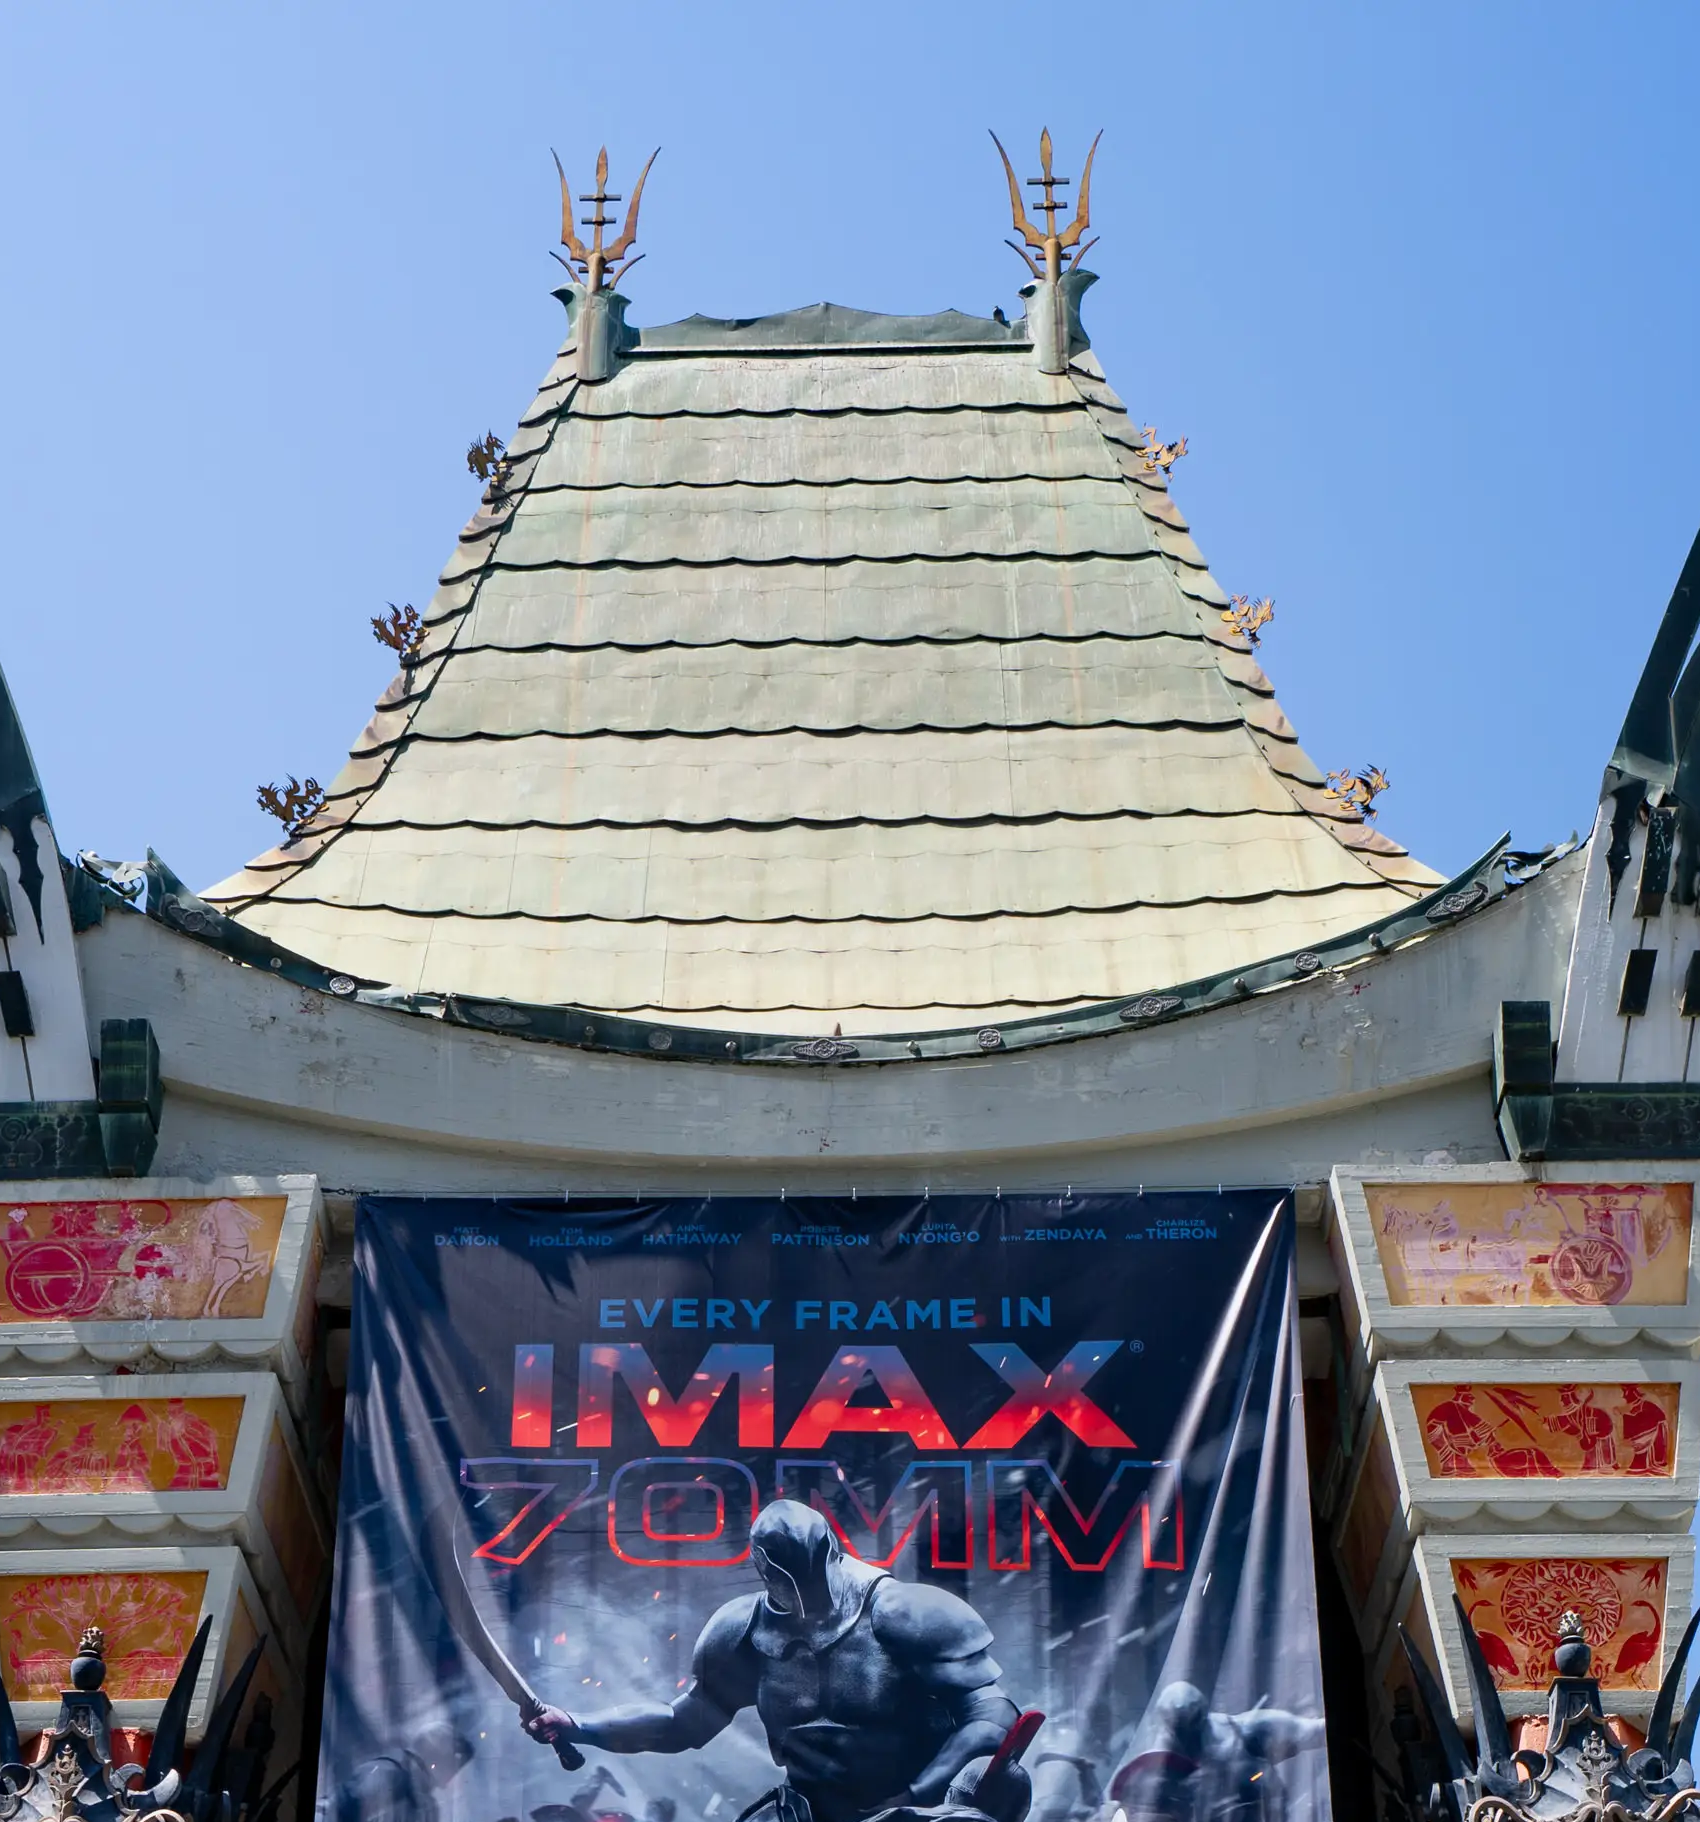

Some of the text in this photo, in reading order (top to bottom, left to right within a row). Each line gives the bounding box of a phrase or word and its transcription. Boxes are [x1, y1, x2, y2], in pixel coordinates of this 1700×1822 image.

[677, 1224, 704, 1233] ANNE
[800, 1226, 841, 1235] ROBERT
[922, 1223, 956, 1232] LUPITA
[1157, 1219, 1205, 1228] CHARLIZE
[560, 1227, 584, 1236] TOM
[898, 1231, 980, 1245] NYONG'O
[1000, 1228, 1106, 1242] WITH ZENDAYA
[1146, 1226, 1217, 1240] THERON
[434, 1233, 499, 1246] DAMON
[529, 1233, 612, 1247] HOLLAND
[642, 1232, 742, 1246] HATHAWAY
[771, 1232, 869, 1246] PATTINSON
[599, 1296, 1052, 1331] EVERY FRAME IN
[459, 1457, 1185, 1572] 70MM
